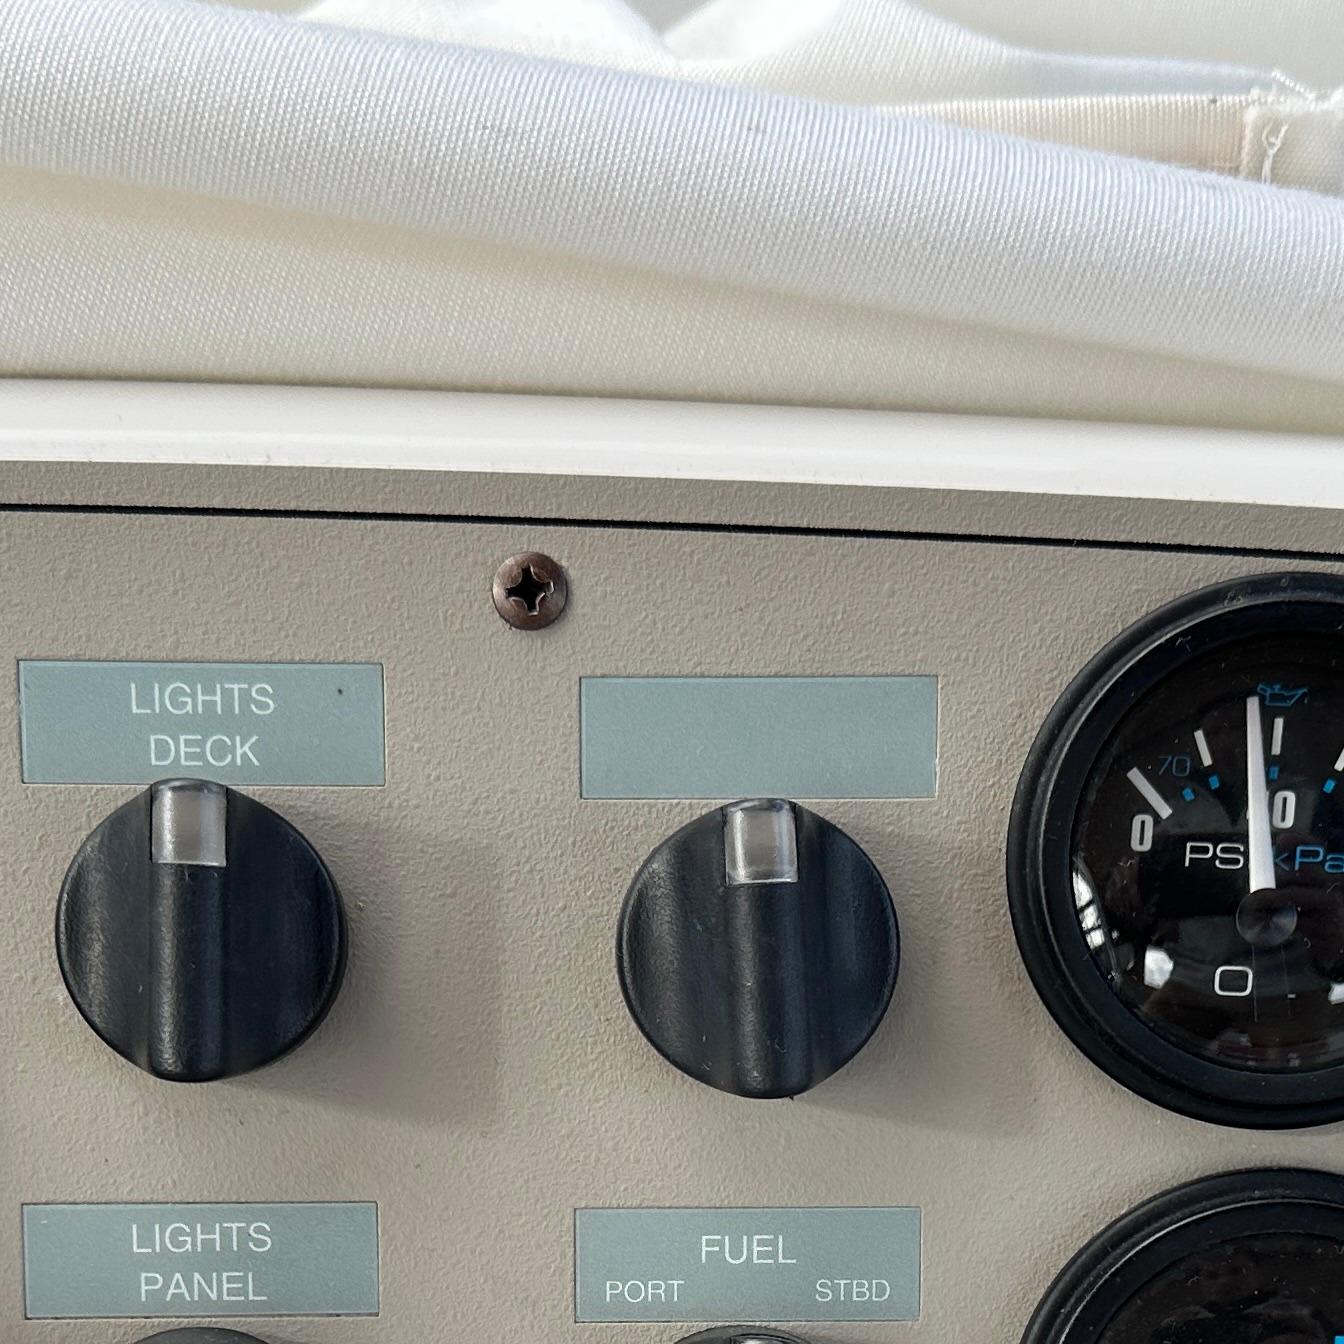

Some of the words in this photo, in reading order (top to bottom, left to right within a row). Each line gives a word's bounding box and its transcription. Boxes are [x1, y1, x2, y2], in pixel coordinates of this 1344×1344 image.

[130, 682, 275, 714] LIGHTS
[149, 735, 260, 766] DECK
[1158, 756, 1190, 777] 70
[1130, 814, 1153, 851] 0
[1184, 842, 1246, 869] PS
[131, 1222, 272, 1253] LIGHTS
[701, 1235, 797, 1265] FUEL
[140, 1272, 267, 1301] PANEL
[606, 1280, 685, 1303] PORT
[815, 1279, 891, 1302] STBD
